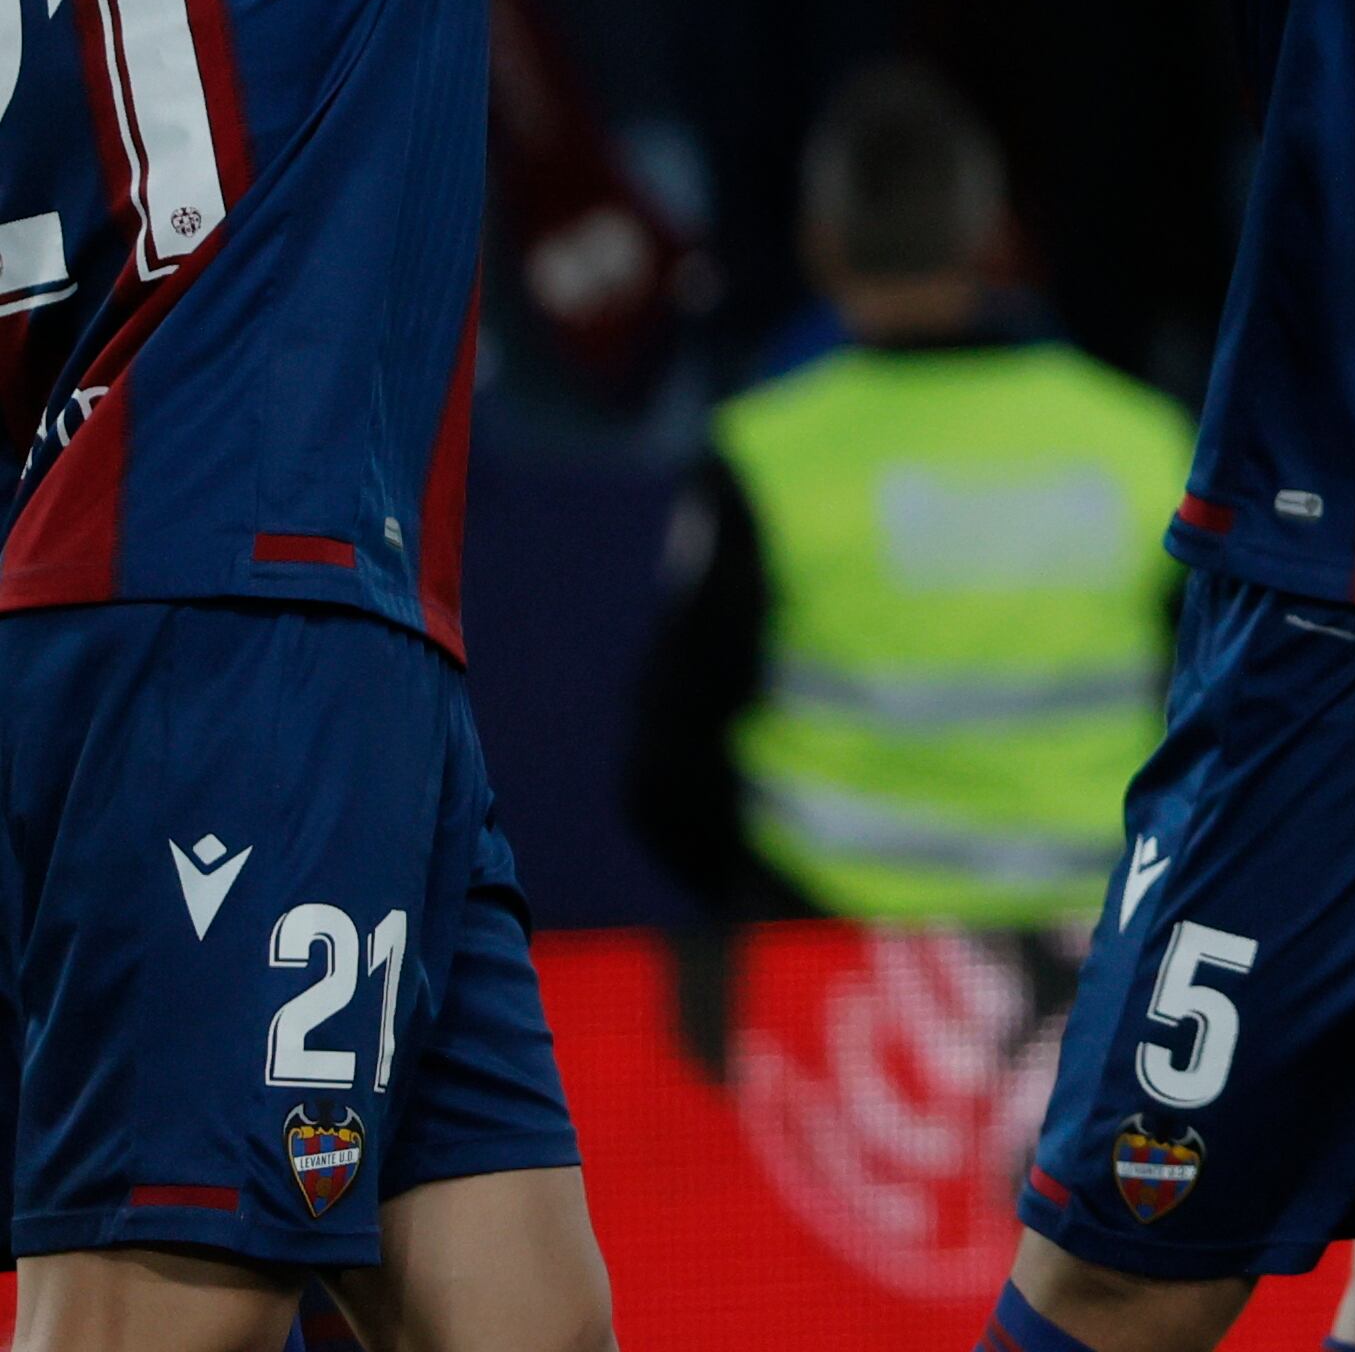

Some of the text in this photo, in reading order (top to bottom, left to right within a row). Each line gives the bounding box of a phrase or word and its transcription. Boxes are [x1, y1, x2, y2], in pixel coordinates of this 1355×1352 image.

[265, 903, 407, 1093] 21
[1135, 920, 1258, 1109] 5
[300, 1153, 337, 1169] LEVANTE
